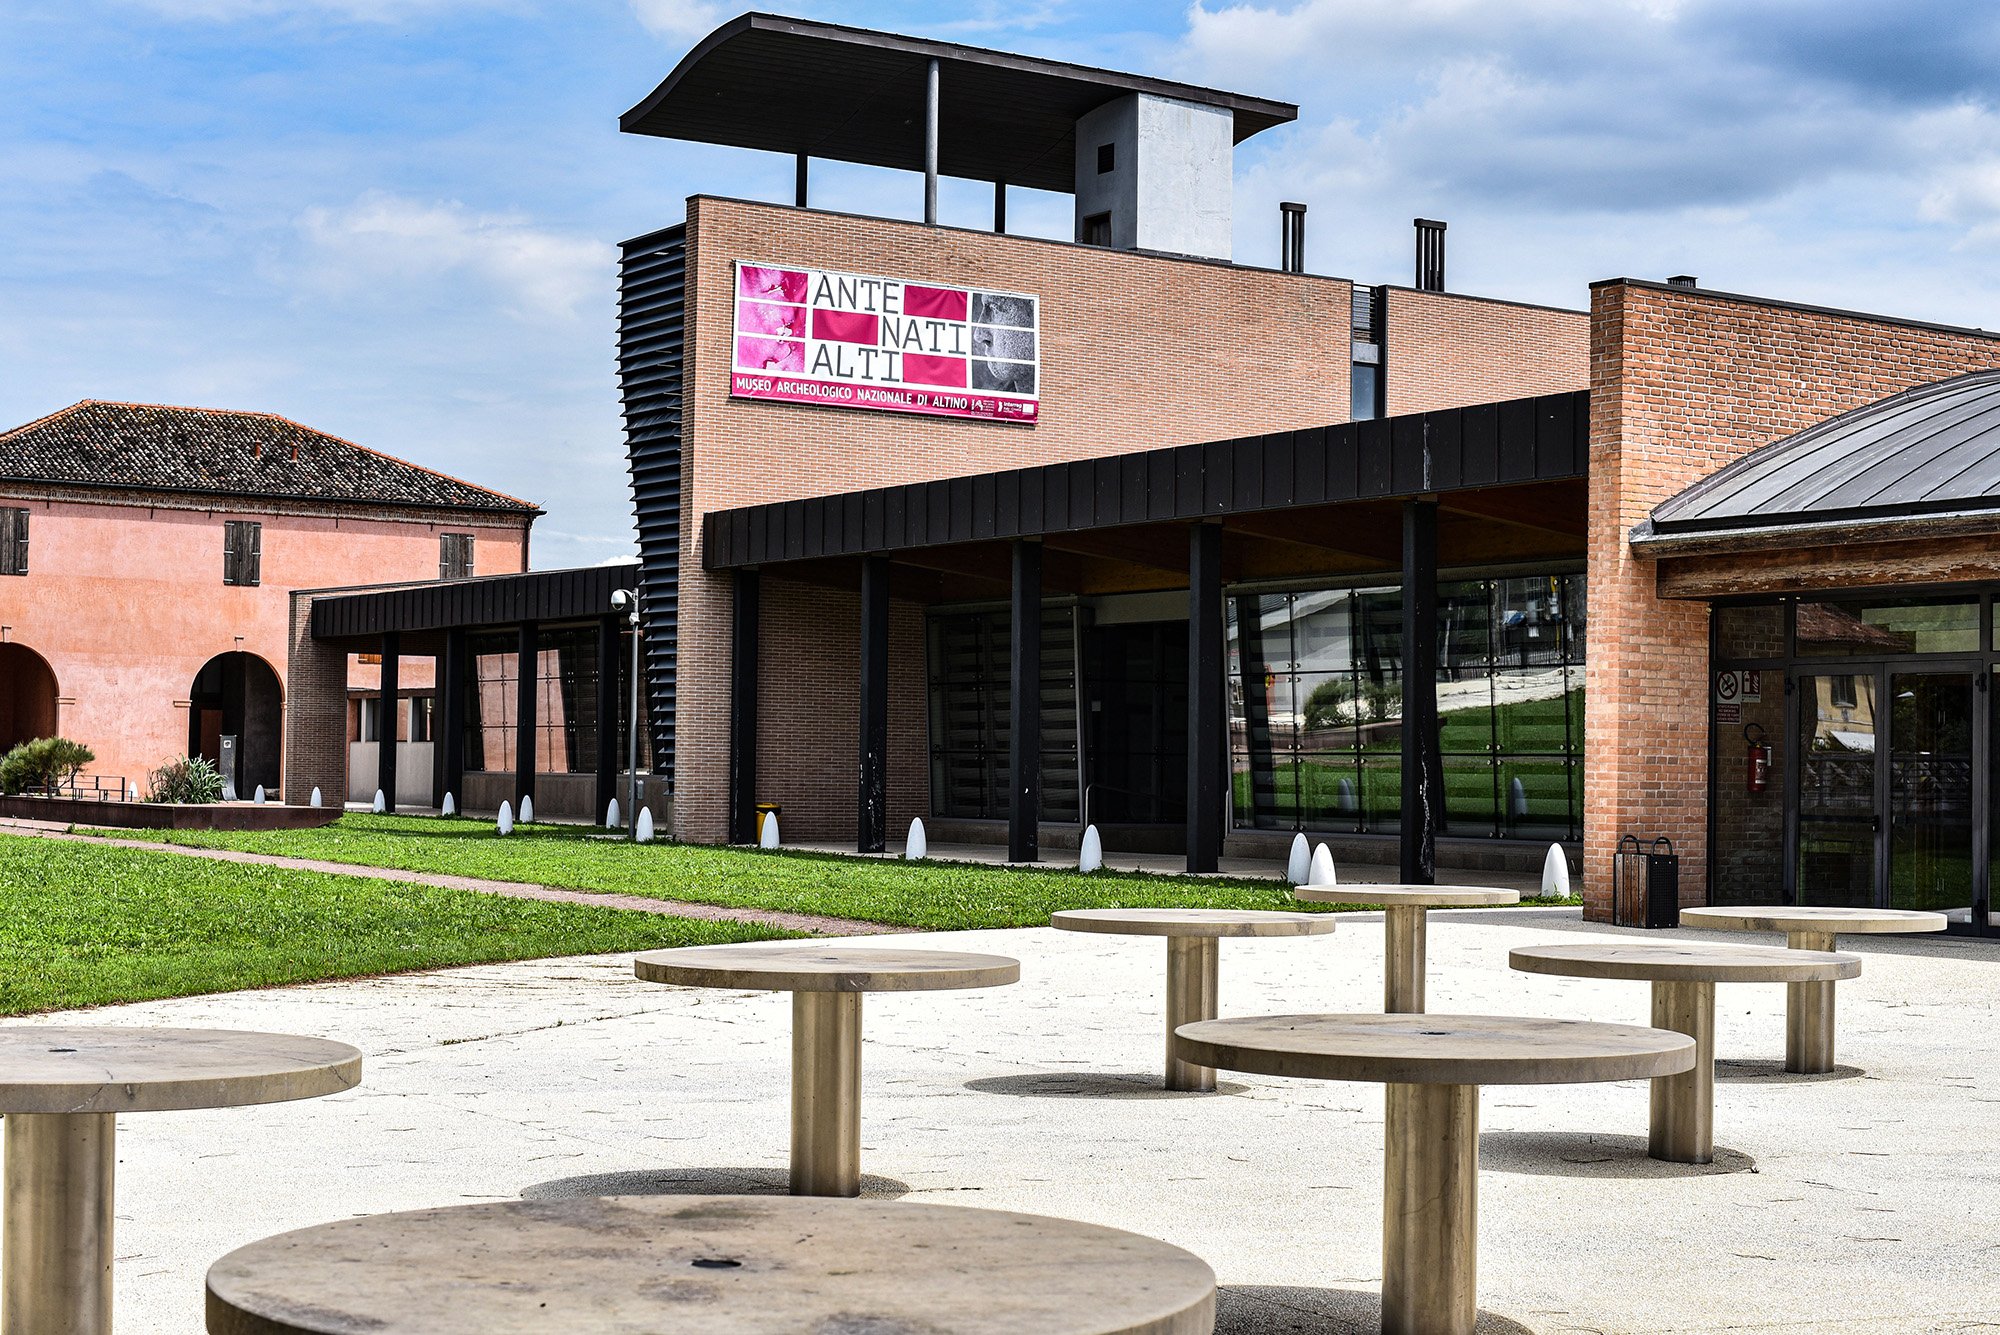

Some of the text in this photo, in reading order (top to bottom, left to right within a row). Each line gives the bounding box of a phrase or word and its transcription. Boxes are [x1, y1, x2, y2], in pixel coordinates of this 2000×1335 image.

[813, 274, 900, 315] ANTE
[882, 315, 967, 355] NATI
[811, 343, 900, 383] ALTI
[736, 376, 772, 392] MUSEO
[776, 381, 853, 399] ARCHEOLOGICO
[857, 388, 913, 405] NAZIONALE
[917, 394, 928, 406] DI
[932, 395, 968, 410] ALTINO
